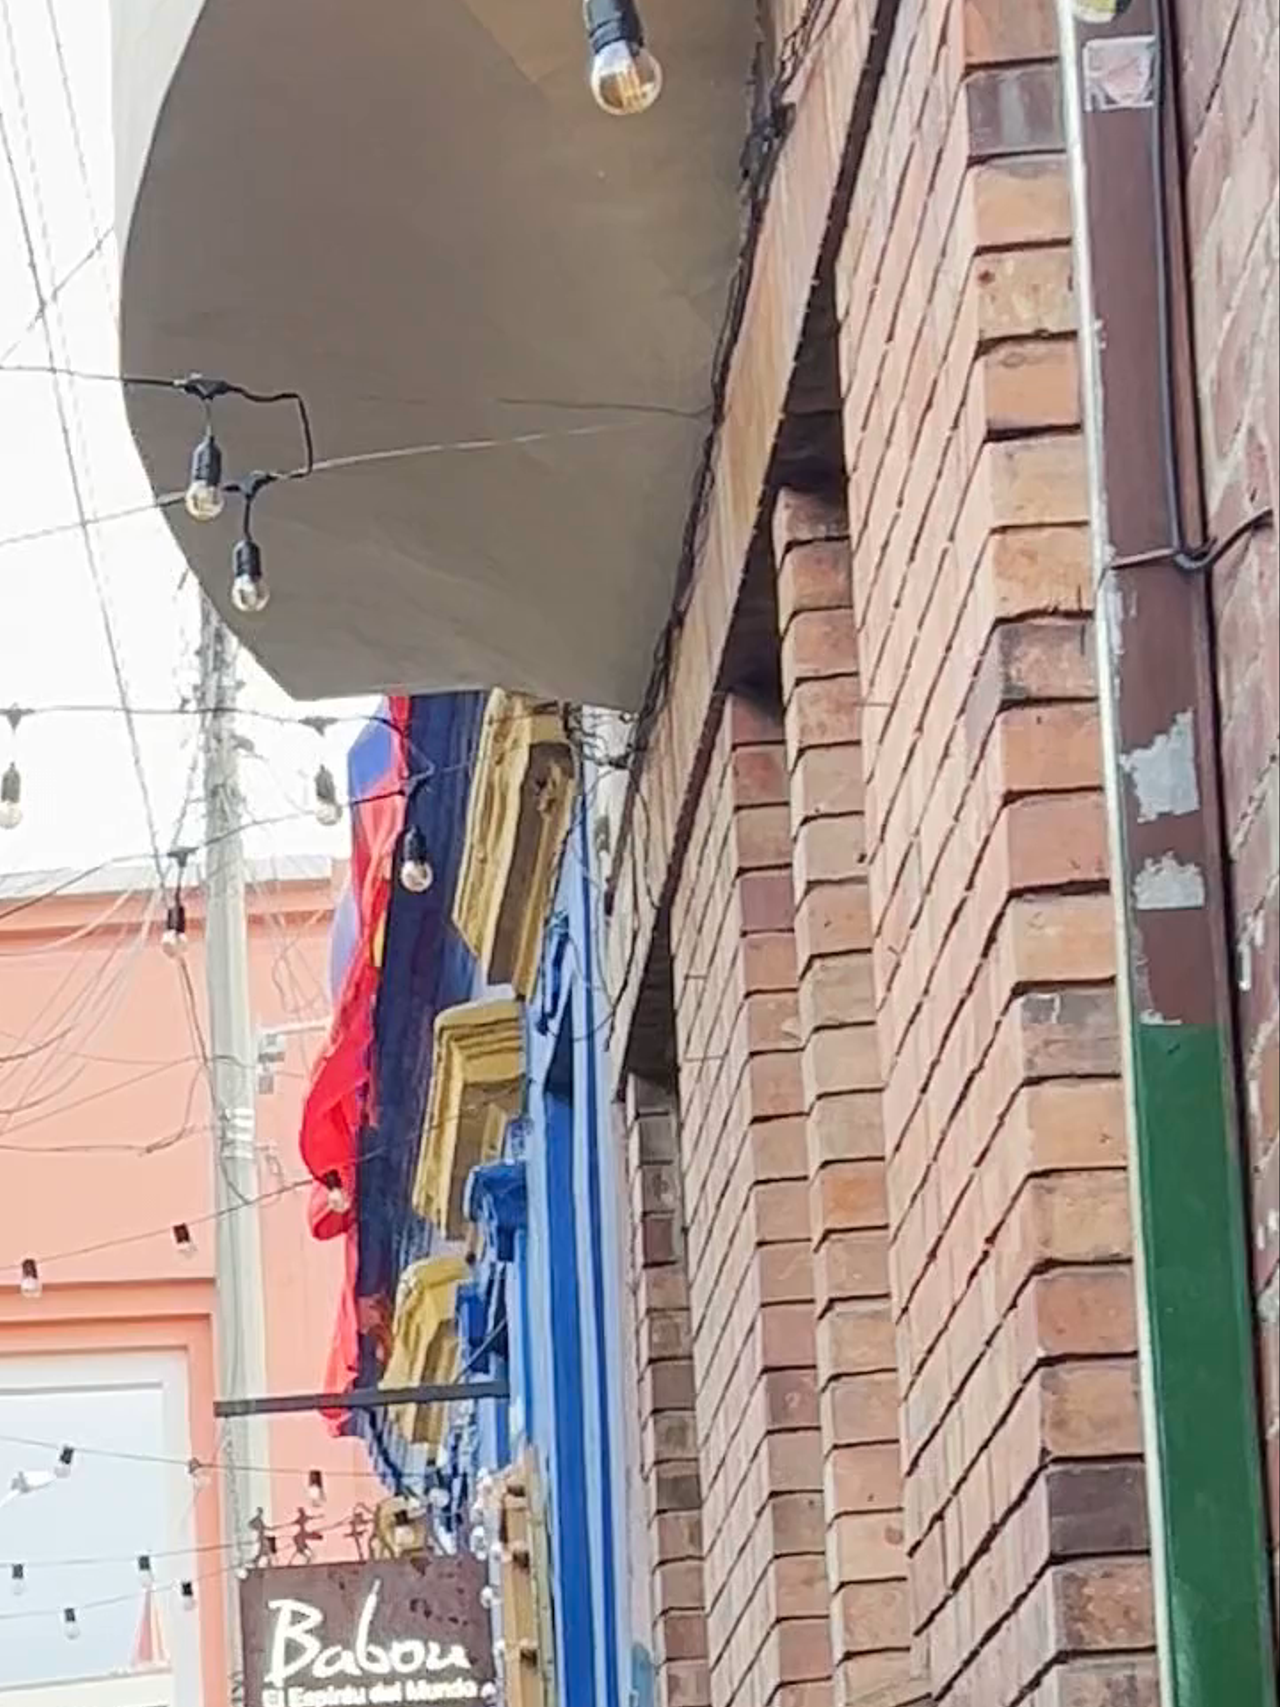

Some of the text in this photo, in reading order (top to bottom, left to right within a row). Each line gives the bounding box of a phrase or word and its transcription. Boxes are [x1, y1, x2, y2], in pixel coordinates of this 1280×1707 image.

[263, 1578, 473, 1688] Babou
[368, 1680, 403, 1704] del
[405, 1676, 479, 1702] Mundo
